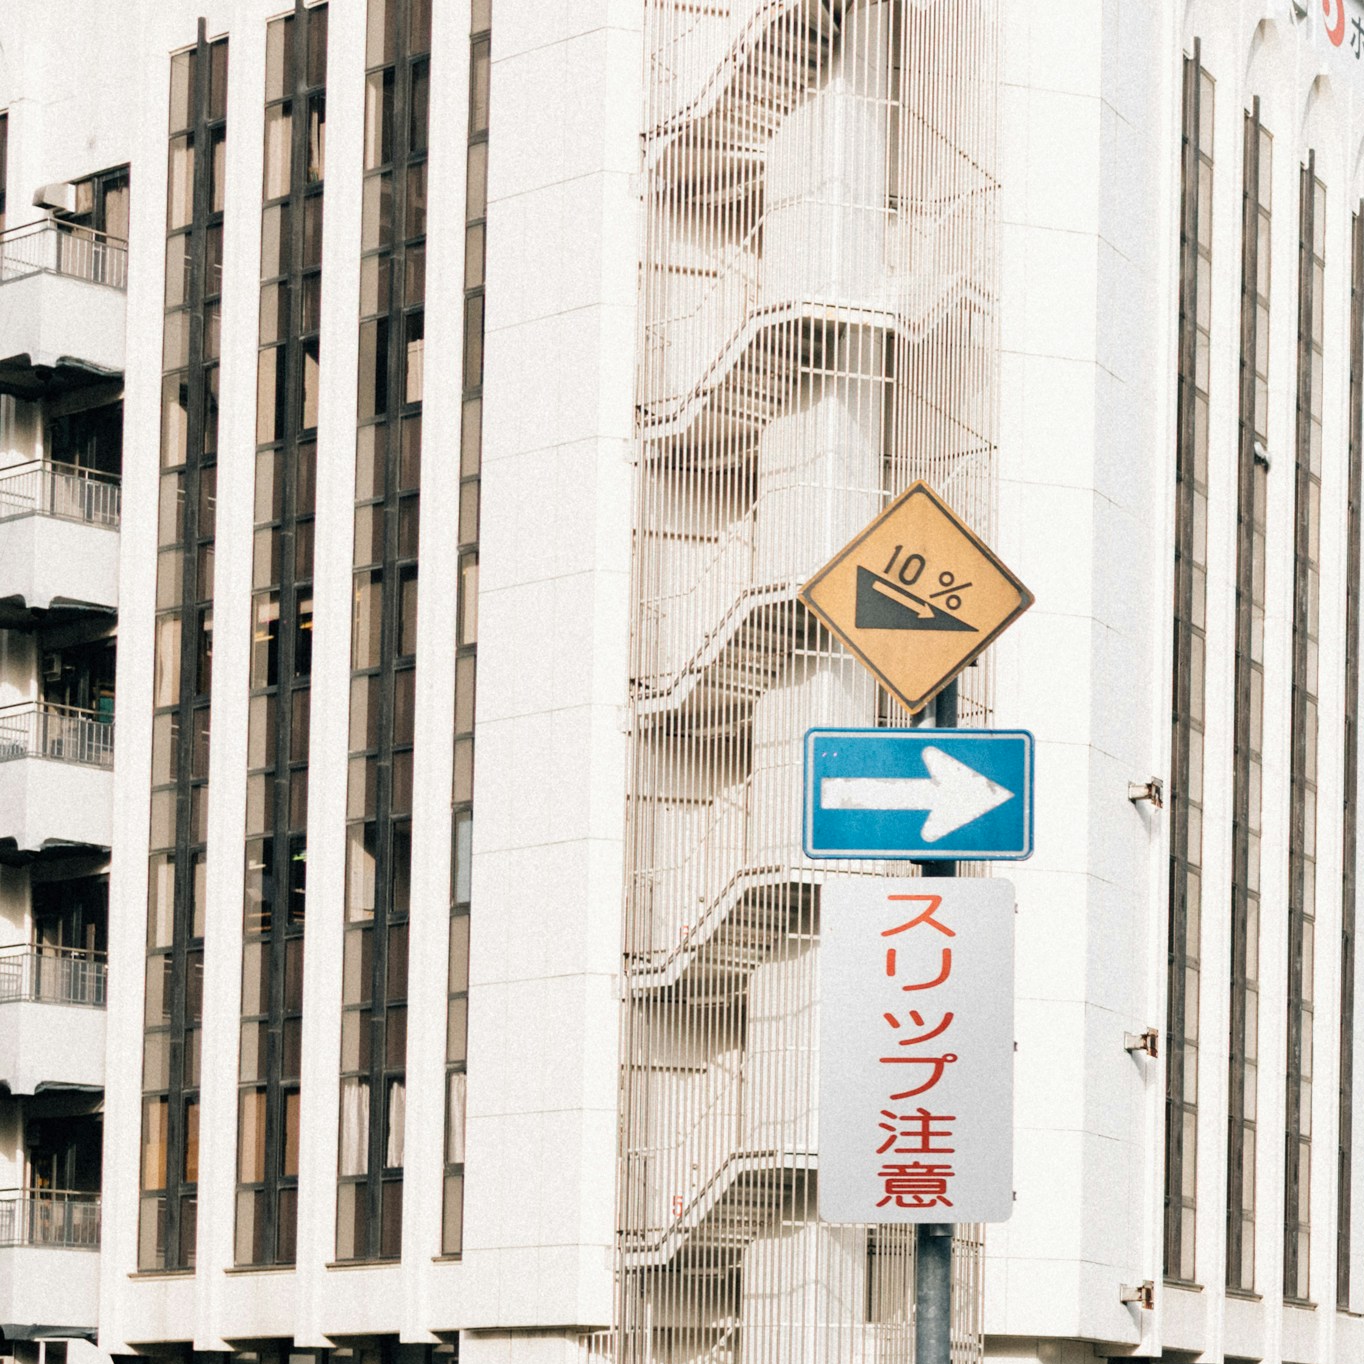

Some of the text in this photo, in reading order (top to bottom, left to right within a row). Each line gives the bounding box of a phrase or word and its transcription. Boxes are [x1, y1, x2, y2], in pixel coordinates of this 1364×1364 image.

[876, 894, 958, 1208] スリップ注意
